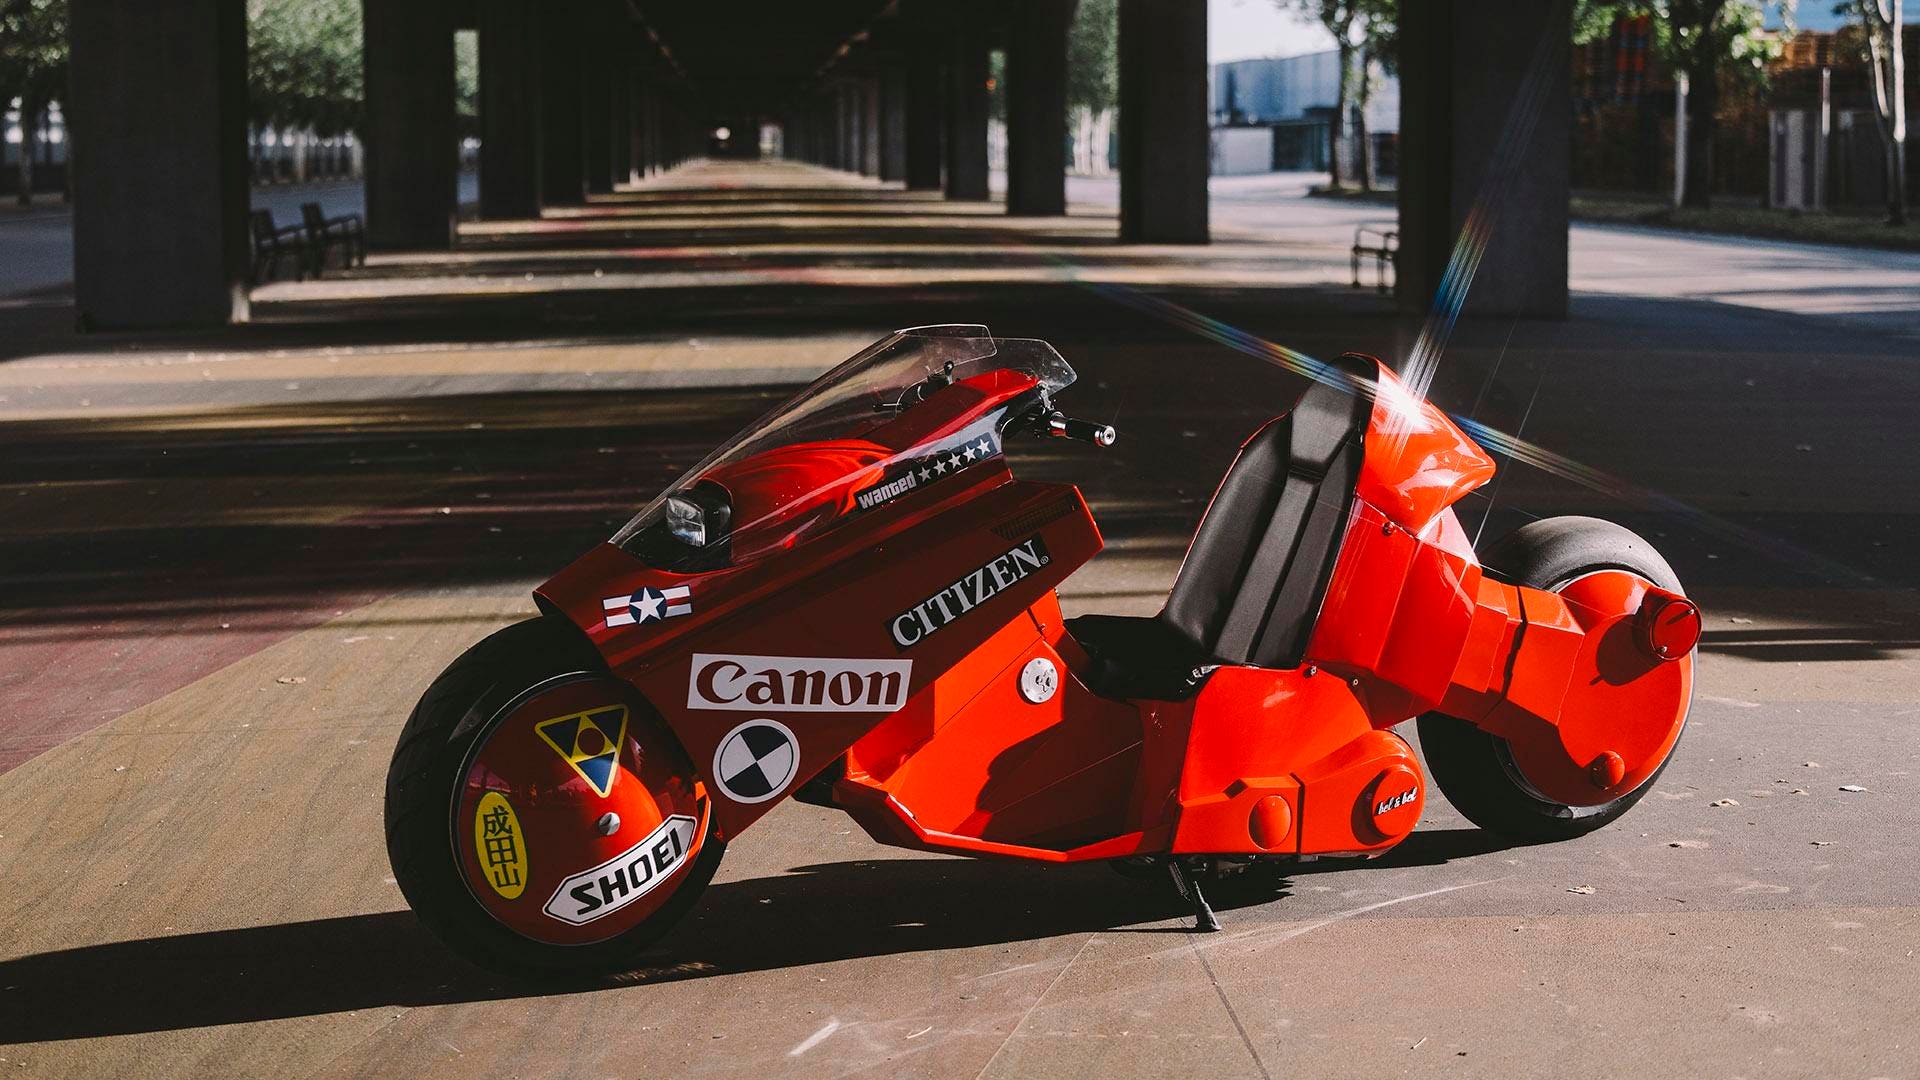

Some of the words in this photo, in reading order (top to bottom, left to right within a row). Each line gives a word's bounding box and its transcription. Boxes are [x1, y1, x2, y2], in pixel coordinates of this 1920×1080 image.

[696, 660, 901, 706] Canon
[485, 805, 521, 888] 成田山
[570, 827, 682, 915] SHOEI
